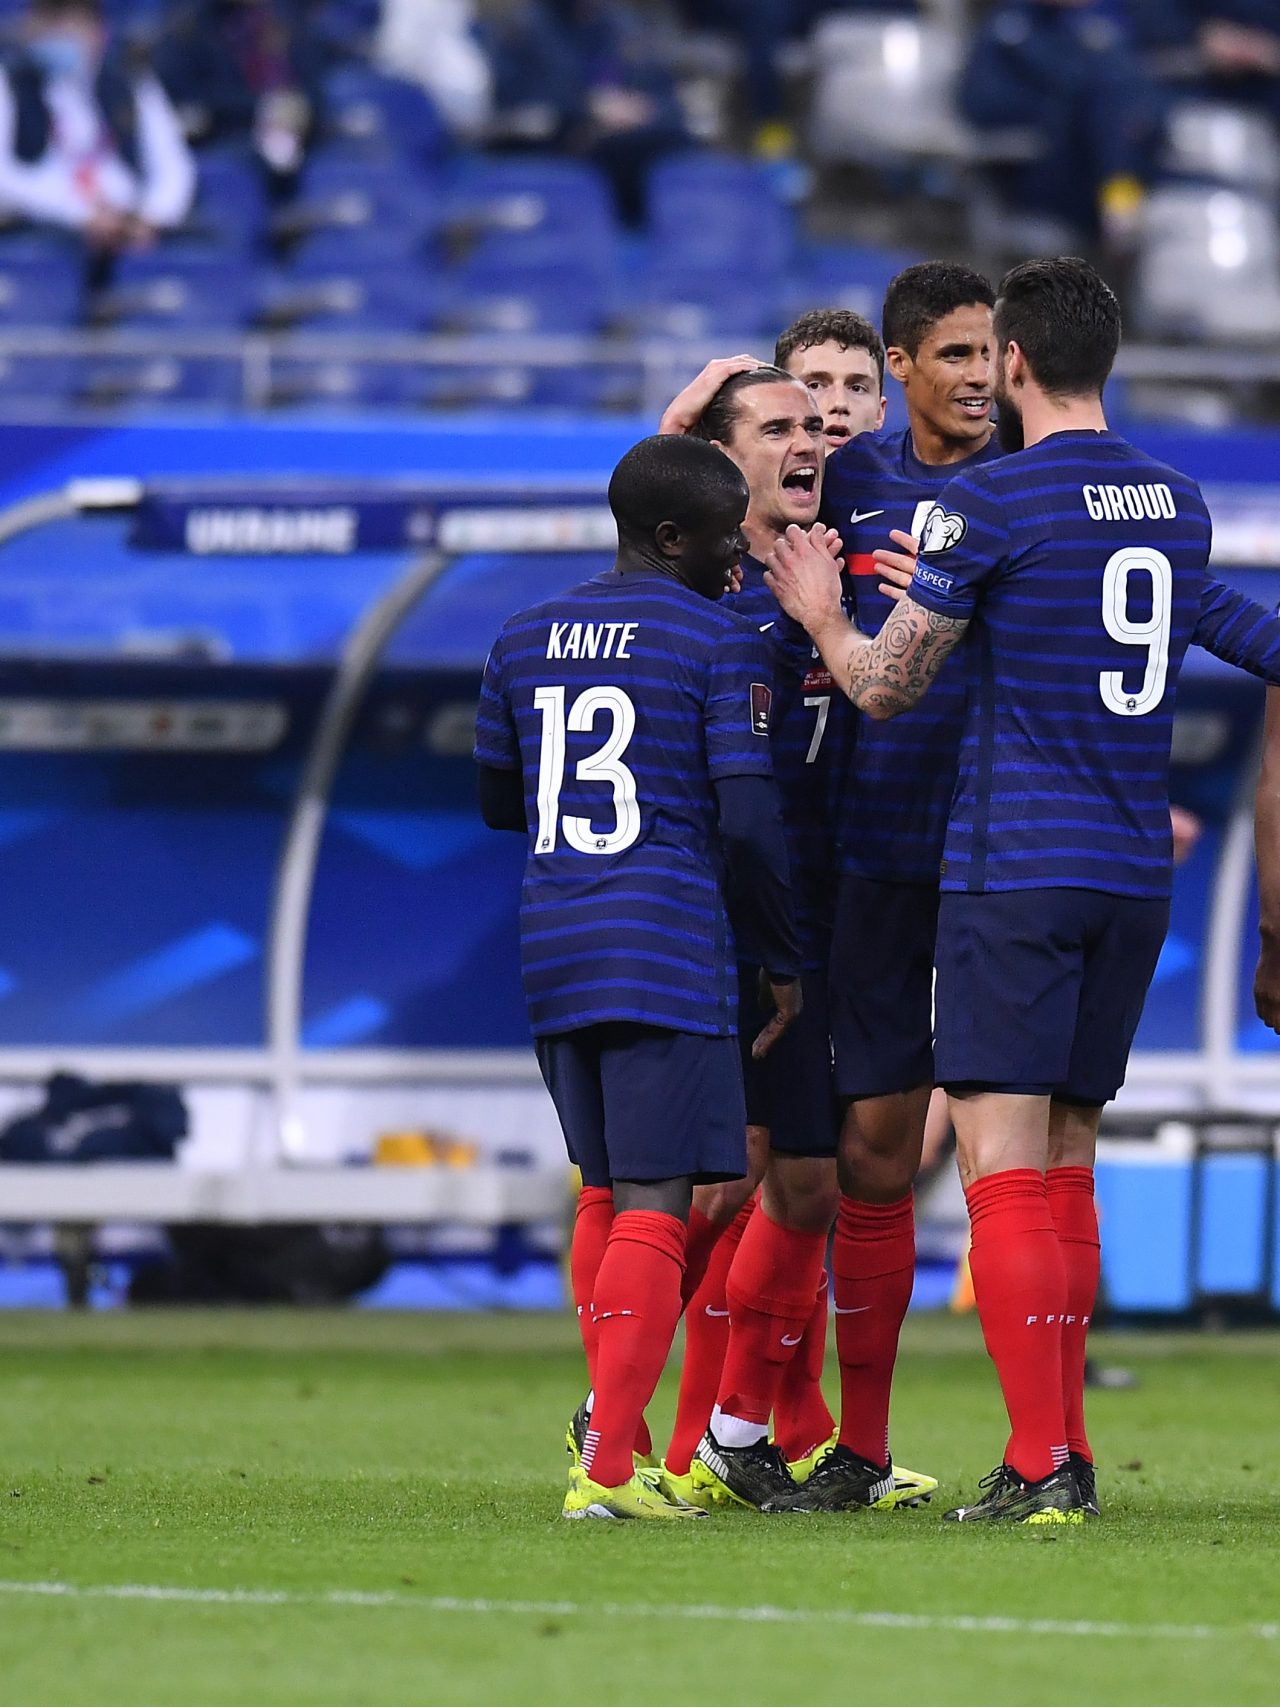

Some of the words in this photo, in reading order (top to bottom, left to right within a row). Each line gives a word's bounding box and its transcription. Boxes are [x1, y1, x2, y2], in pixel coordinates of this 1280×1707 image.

[1082, 483, 1177, 521] GIROUD
[546, 622, 639, 659] KANTE
[1099, 546, 1173, 716] 9
[803, 695, 831, 764] 7
[533, 685, 641, 855] 13
